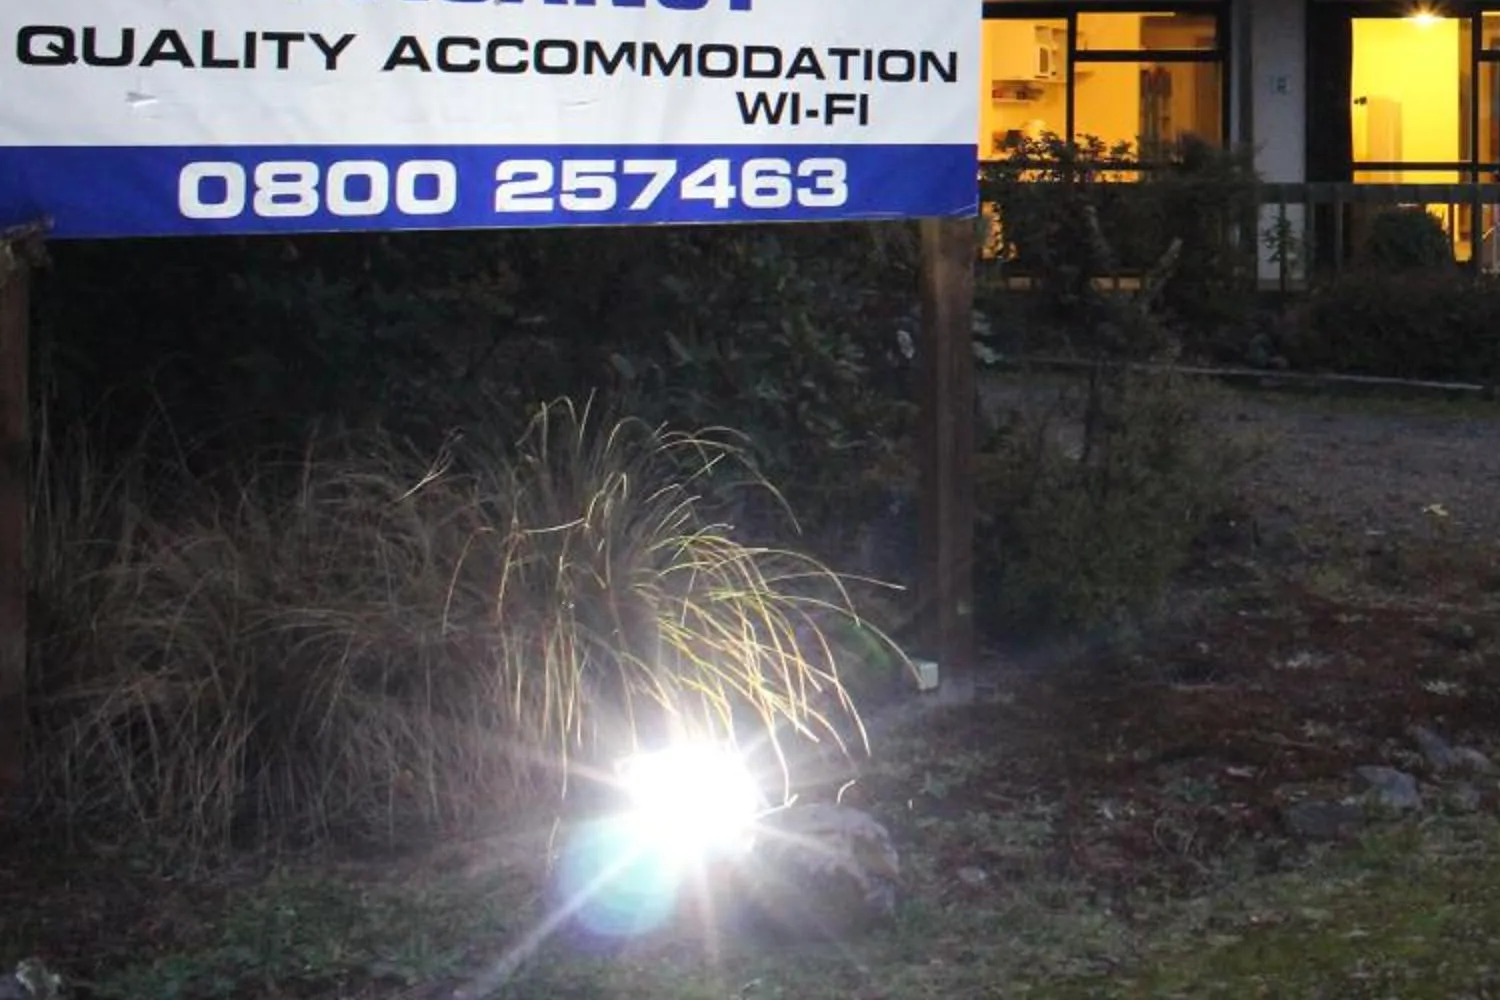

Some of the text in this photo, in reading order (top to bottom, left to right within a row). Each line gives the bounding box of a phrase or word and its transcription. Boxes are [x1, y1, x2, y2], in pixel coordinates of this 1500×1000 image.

[15, 25, 959, 83] QUALITY ACCOMMODATION
[736, 90, 870, 127] WI-FI
[177, 156, 849, 220] 0800 257463
